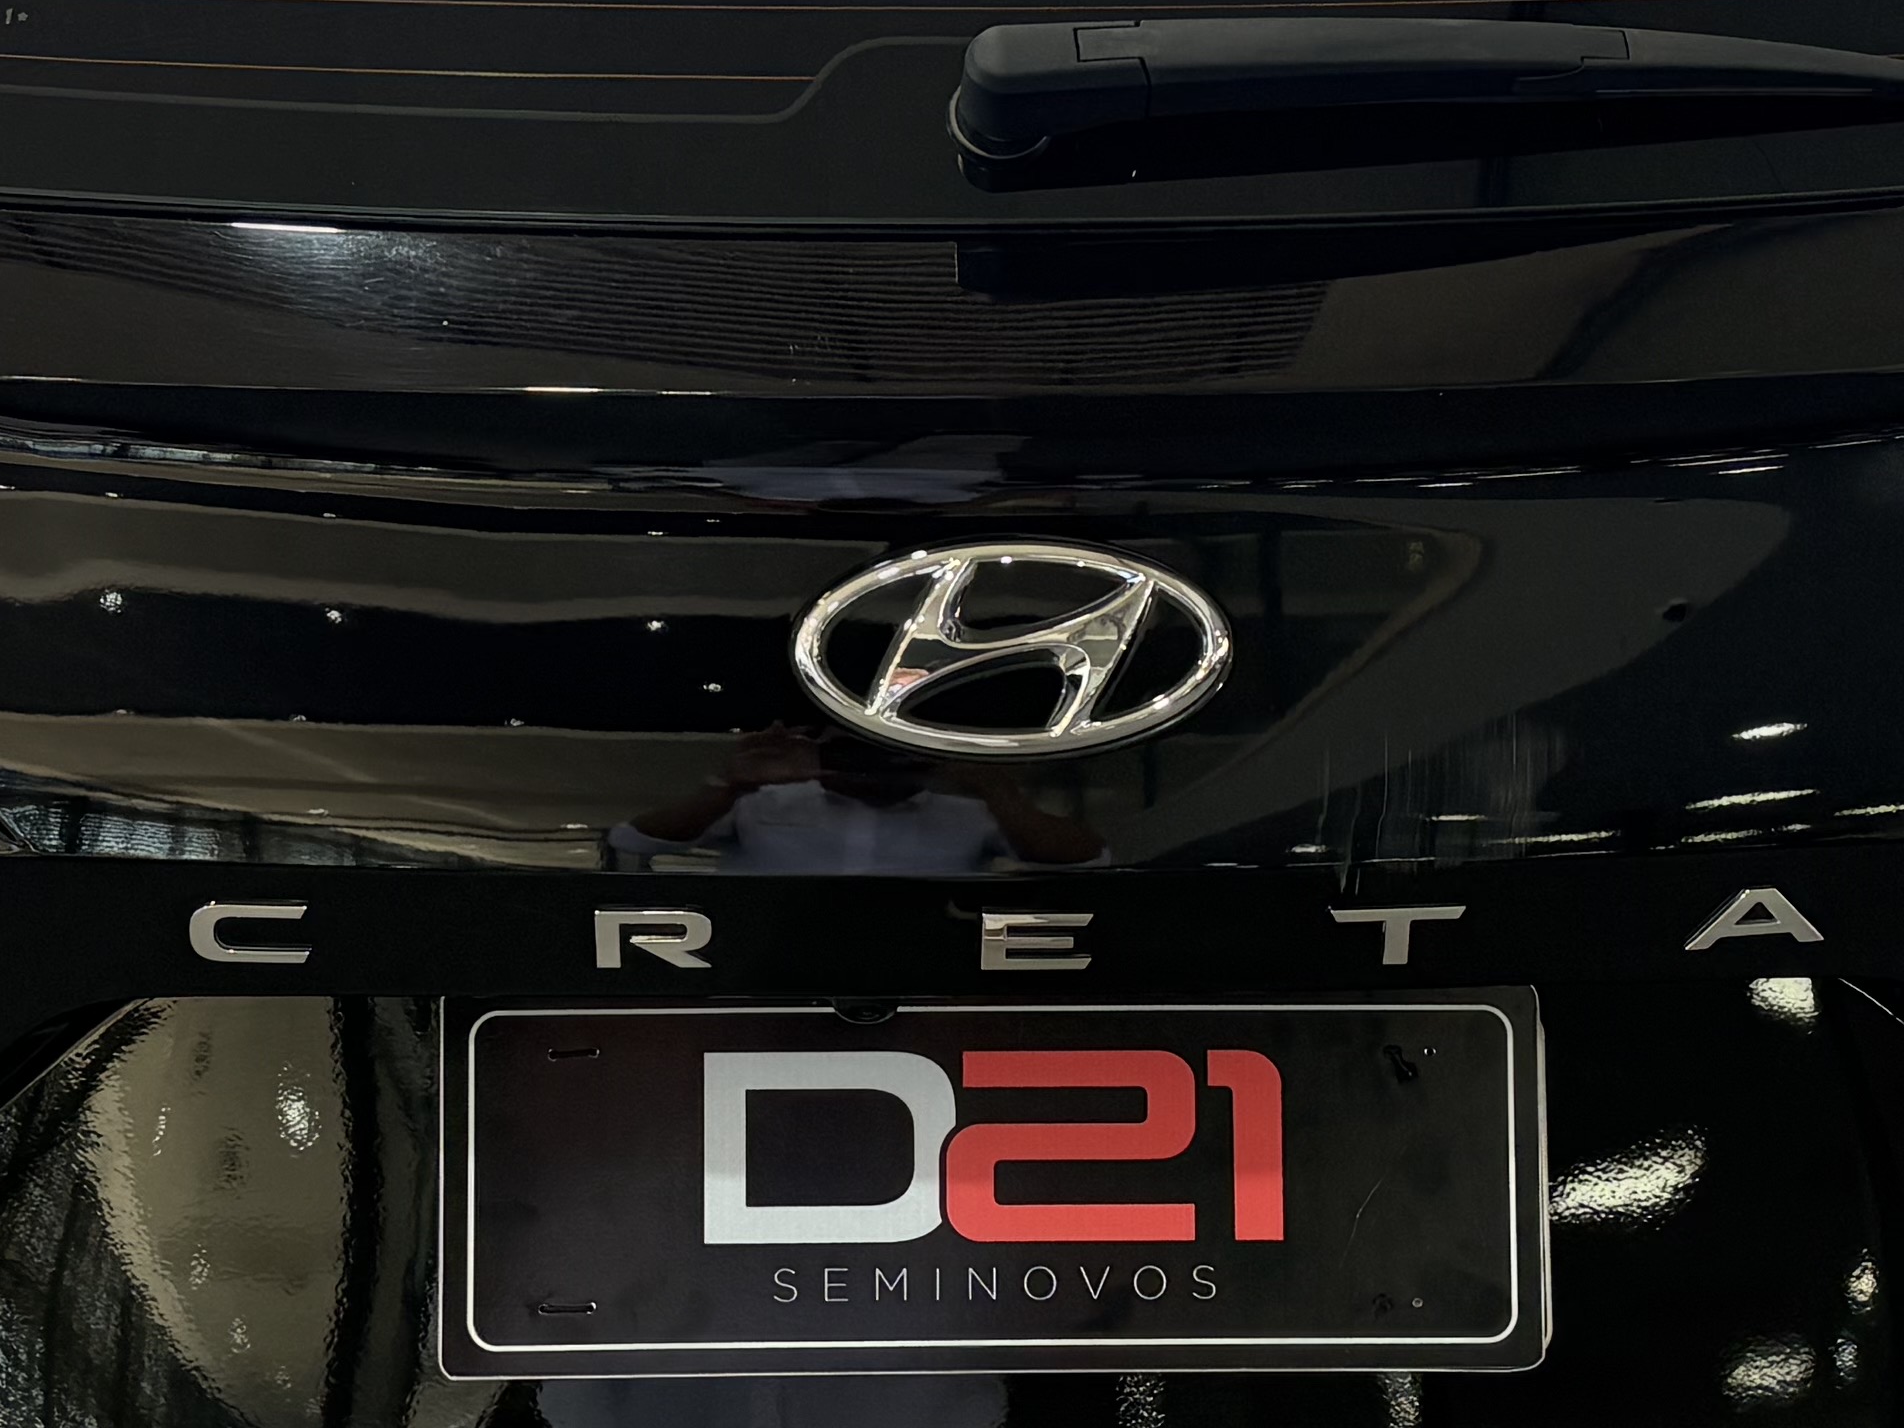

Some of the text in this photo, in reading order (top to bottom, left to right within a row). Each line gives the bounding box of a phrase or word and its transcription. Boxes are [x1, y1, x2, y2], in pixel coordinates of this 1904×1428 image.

[188, 886, 1826, 970] CRETA
[702, 1049, 1285, 1246] D21
[772, 1263, 1219, 1304] SEMINOVOS
